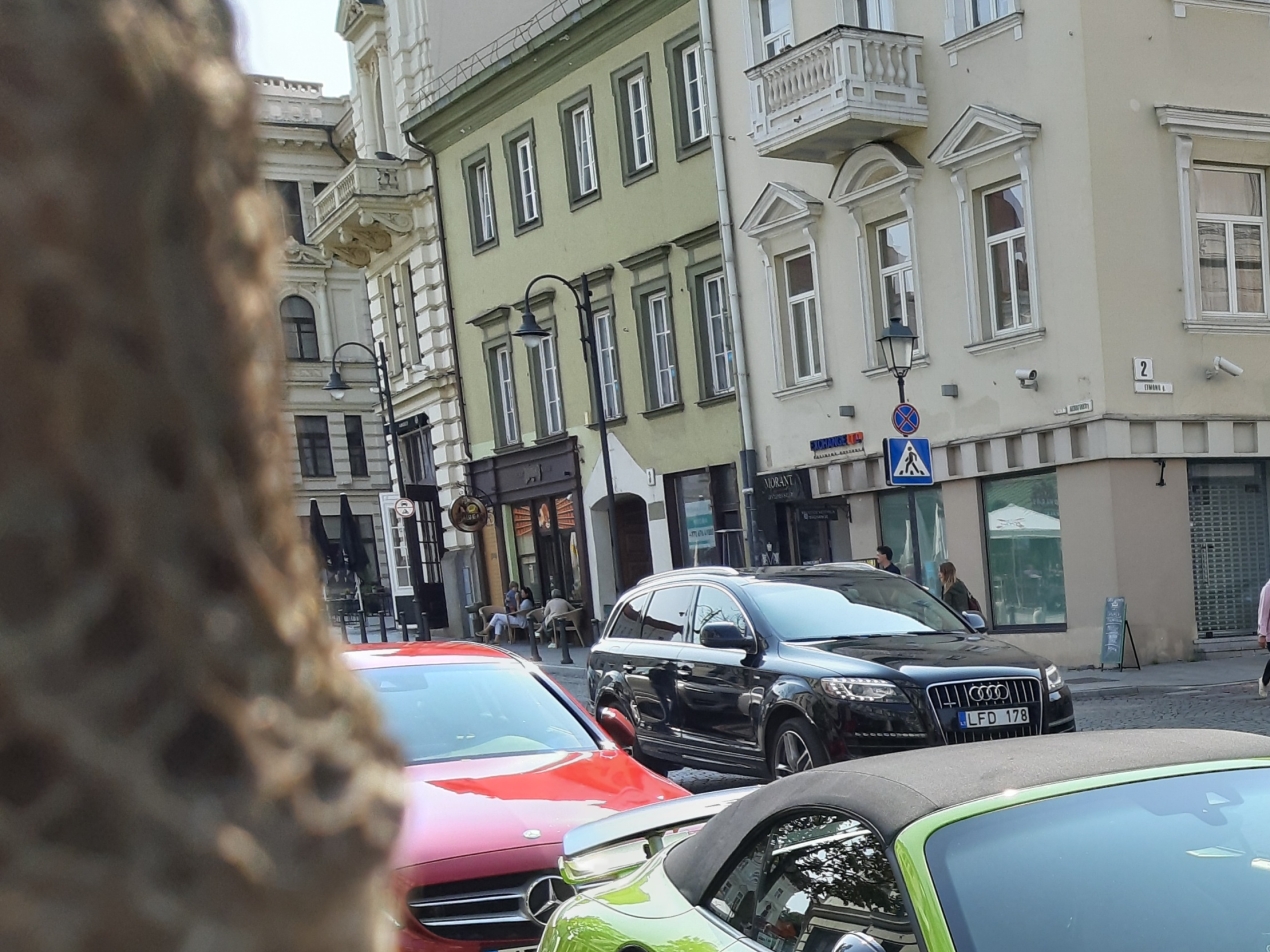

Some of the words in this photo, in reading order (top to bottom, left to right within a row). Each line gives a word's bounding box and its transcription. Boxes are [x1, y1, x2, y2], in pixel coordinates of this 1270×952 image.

[1140, 360, 1148, 377] 2
[967, 711, 997, 726] LFD
[1006, 708, 1028, 723] 178
